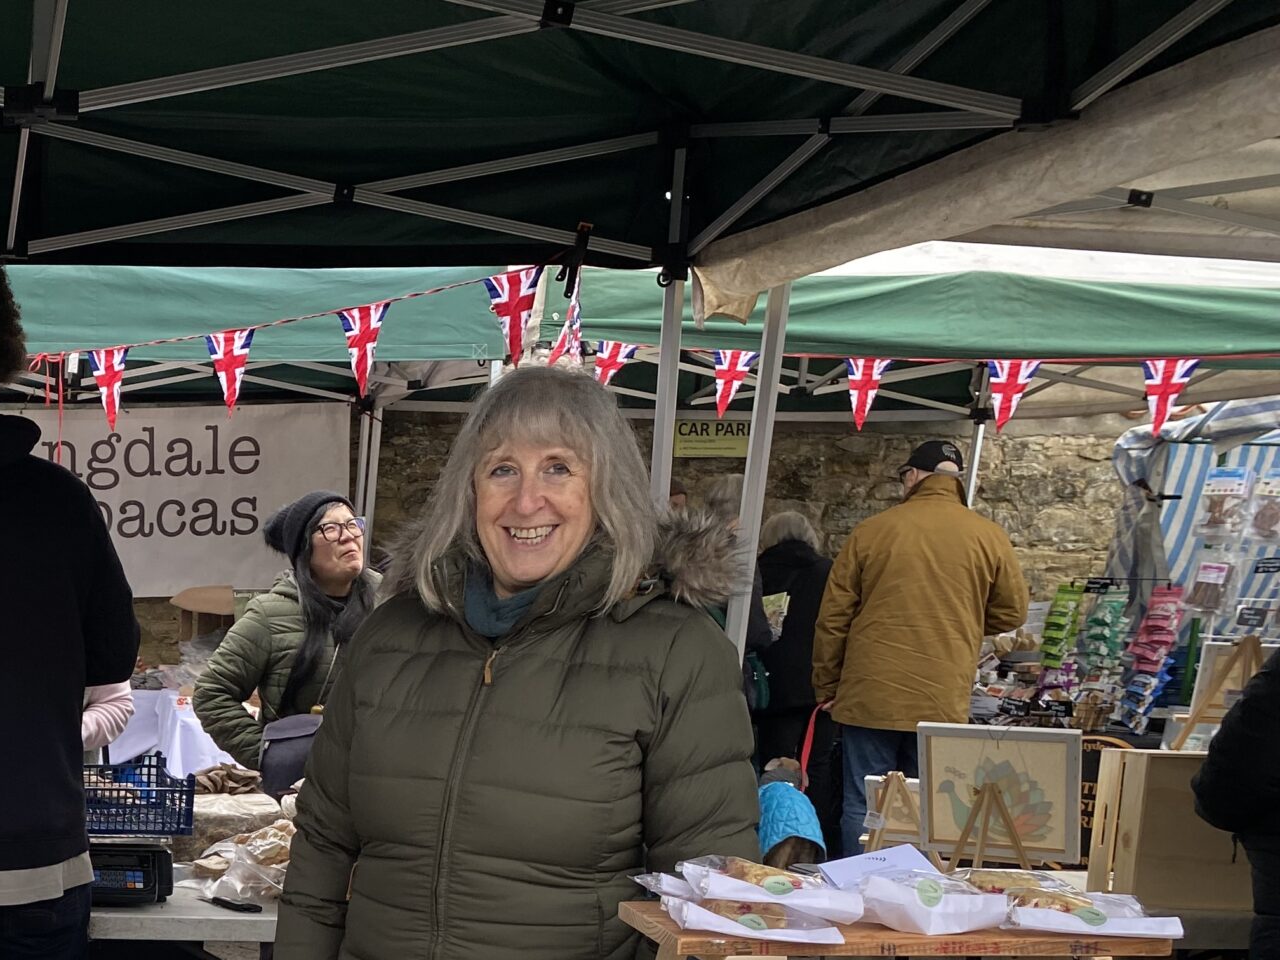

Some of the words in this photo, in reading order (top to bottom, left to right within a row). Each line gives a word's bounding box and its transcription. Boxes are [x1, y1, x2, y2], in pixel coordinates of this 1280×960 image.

[678, 422, 710, 436] CAR
[41, 425, 261, 490] ngdale
[100, 496, 259, 538] acas
